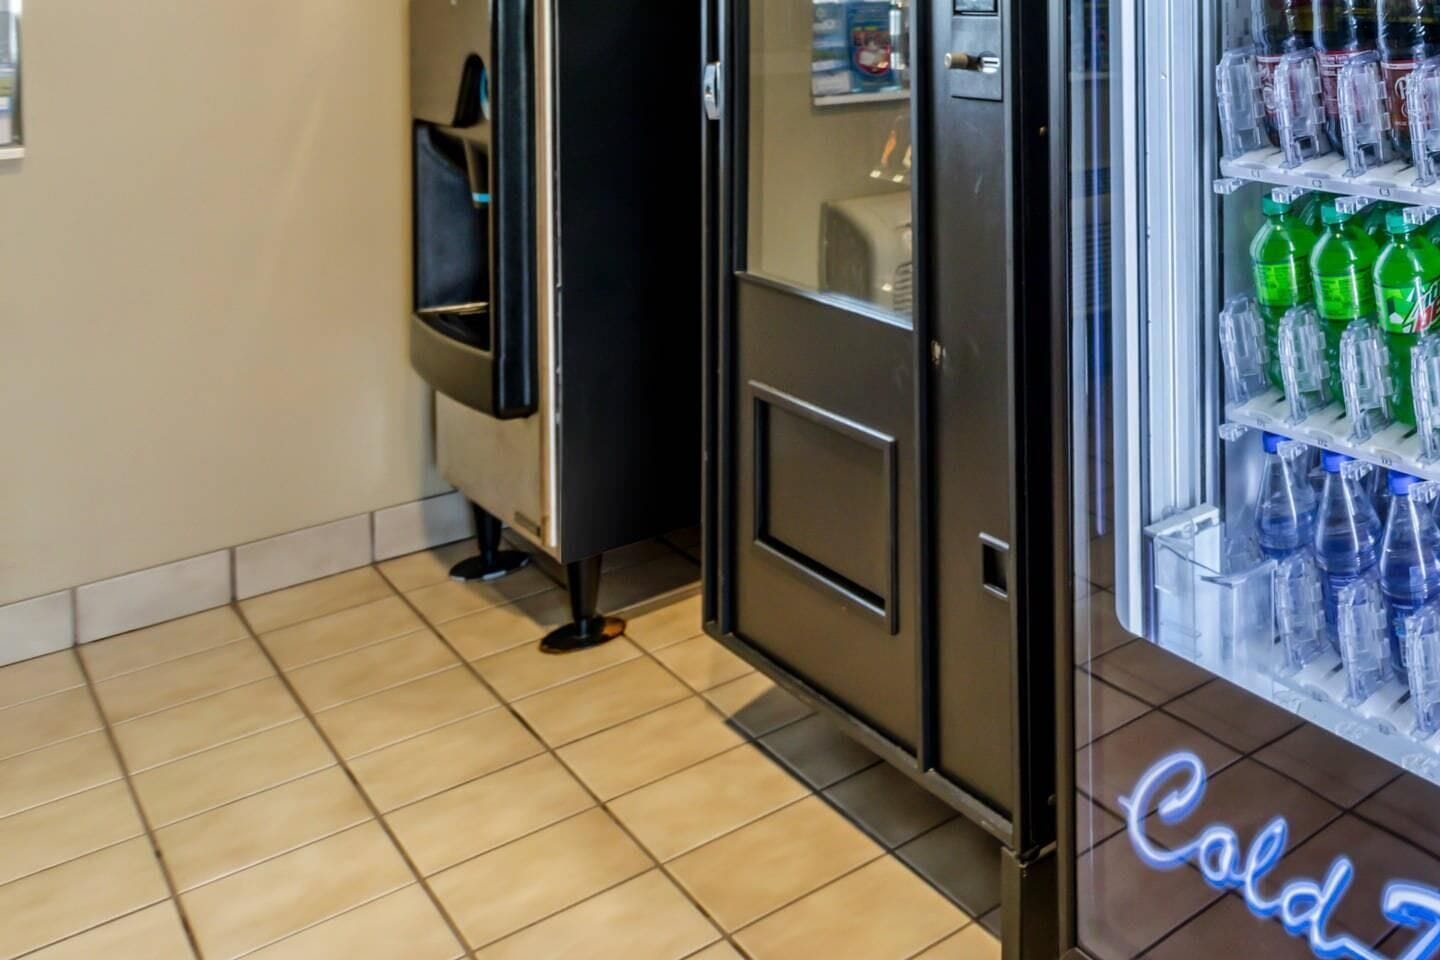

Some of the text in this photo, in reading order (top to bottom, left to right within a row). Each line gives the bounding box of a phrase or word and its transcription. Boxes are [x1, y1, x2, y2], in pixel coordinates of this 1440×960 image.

[1312, 179, 1323, 188] C2
[1379, 188, 1391, 197] C3
[1117, 748, 1366, 959] Cold
